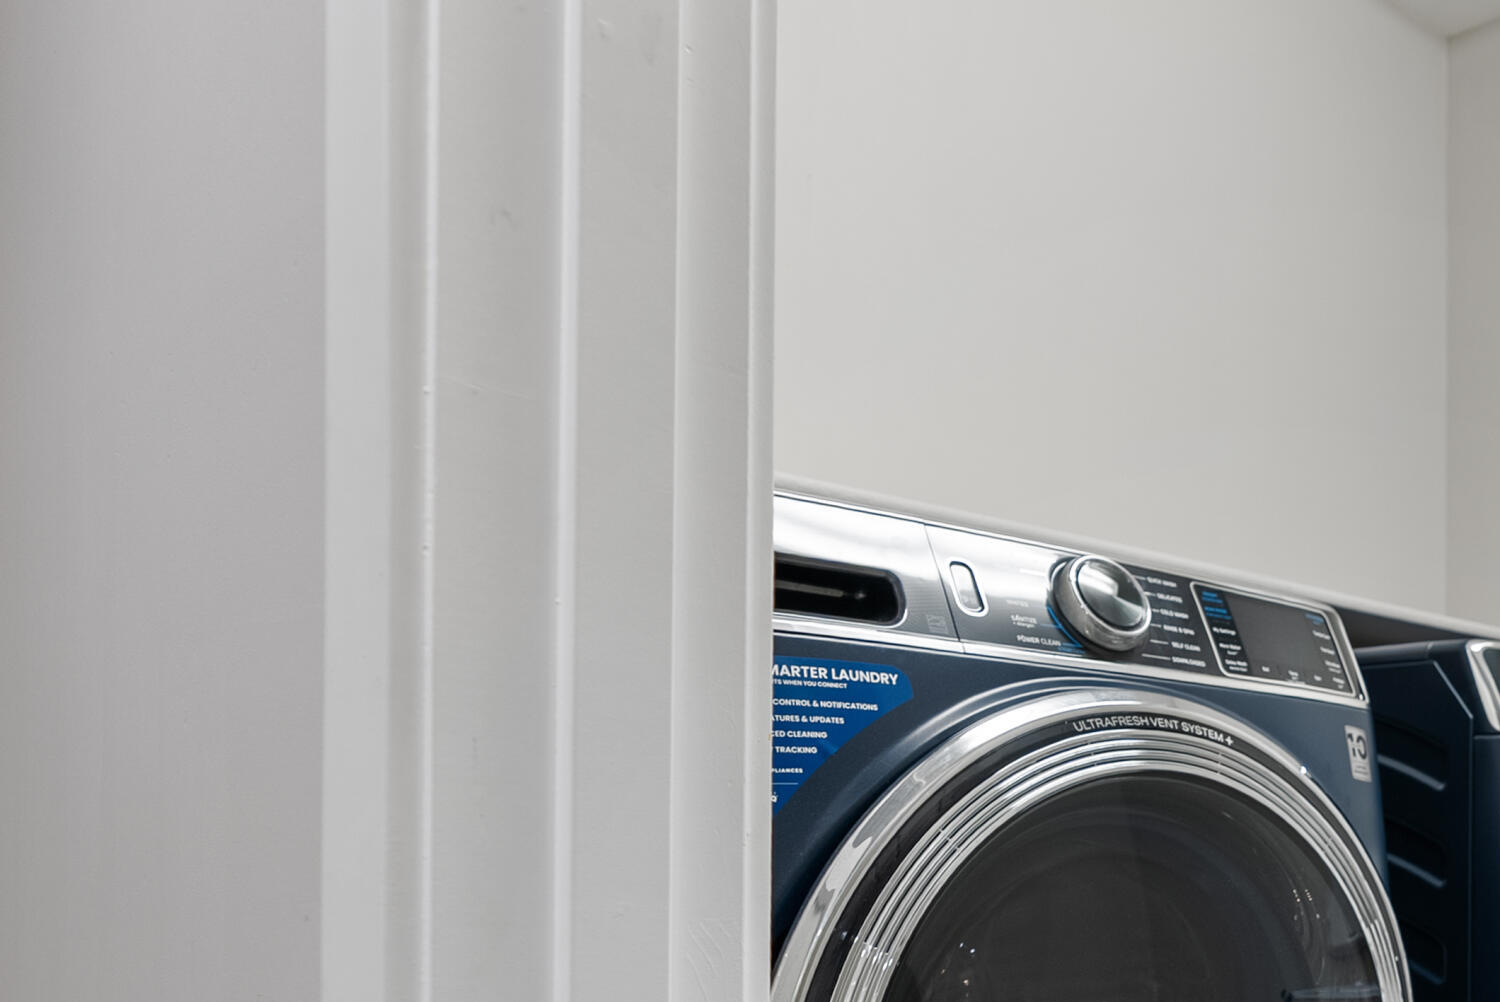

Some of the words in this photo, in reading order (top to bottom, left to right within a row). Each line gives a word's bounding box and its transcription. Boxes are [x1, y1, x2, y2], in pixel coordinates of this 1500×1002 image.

[772, 664, 828, 679] MARTER
[831, 667, 898, 685] LAUNDRY
[818, 681, 847, 689] CONNECT
[773, 698, 811, 707] CONTROL
[820, 701, 878, 711] NOTIFICATIONS
[801, 715, 808, 723] &
[809, 716, 845, 724] UPDATES
[1073, 715, 1149, 732] ULTRAFRESH
[1149, 716, 1179, 729] VENT
[787, 730, 828, 739] CLEANING
[775, 745, 818, 754] TRACKING
